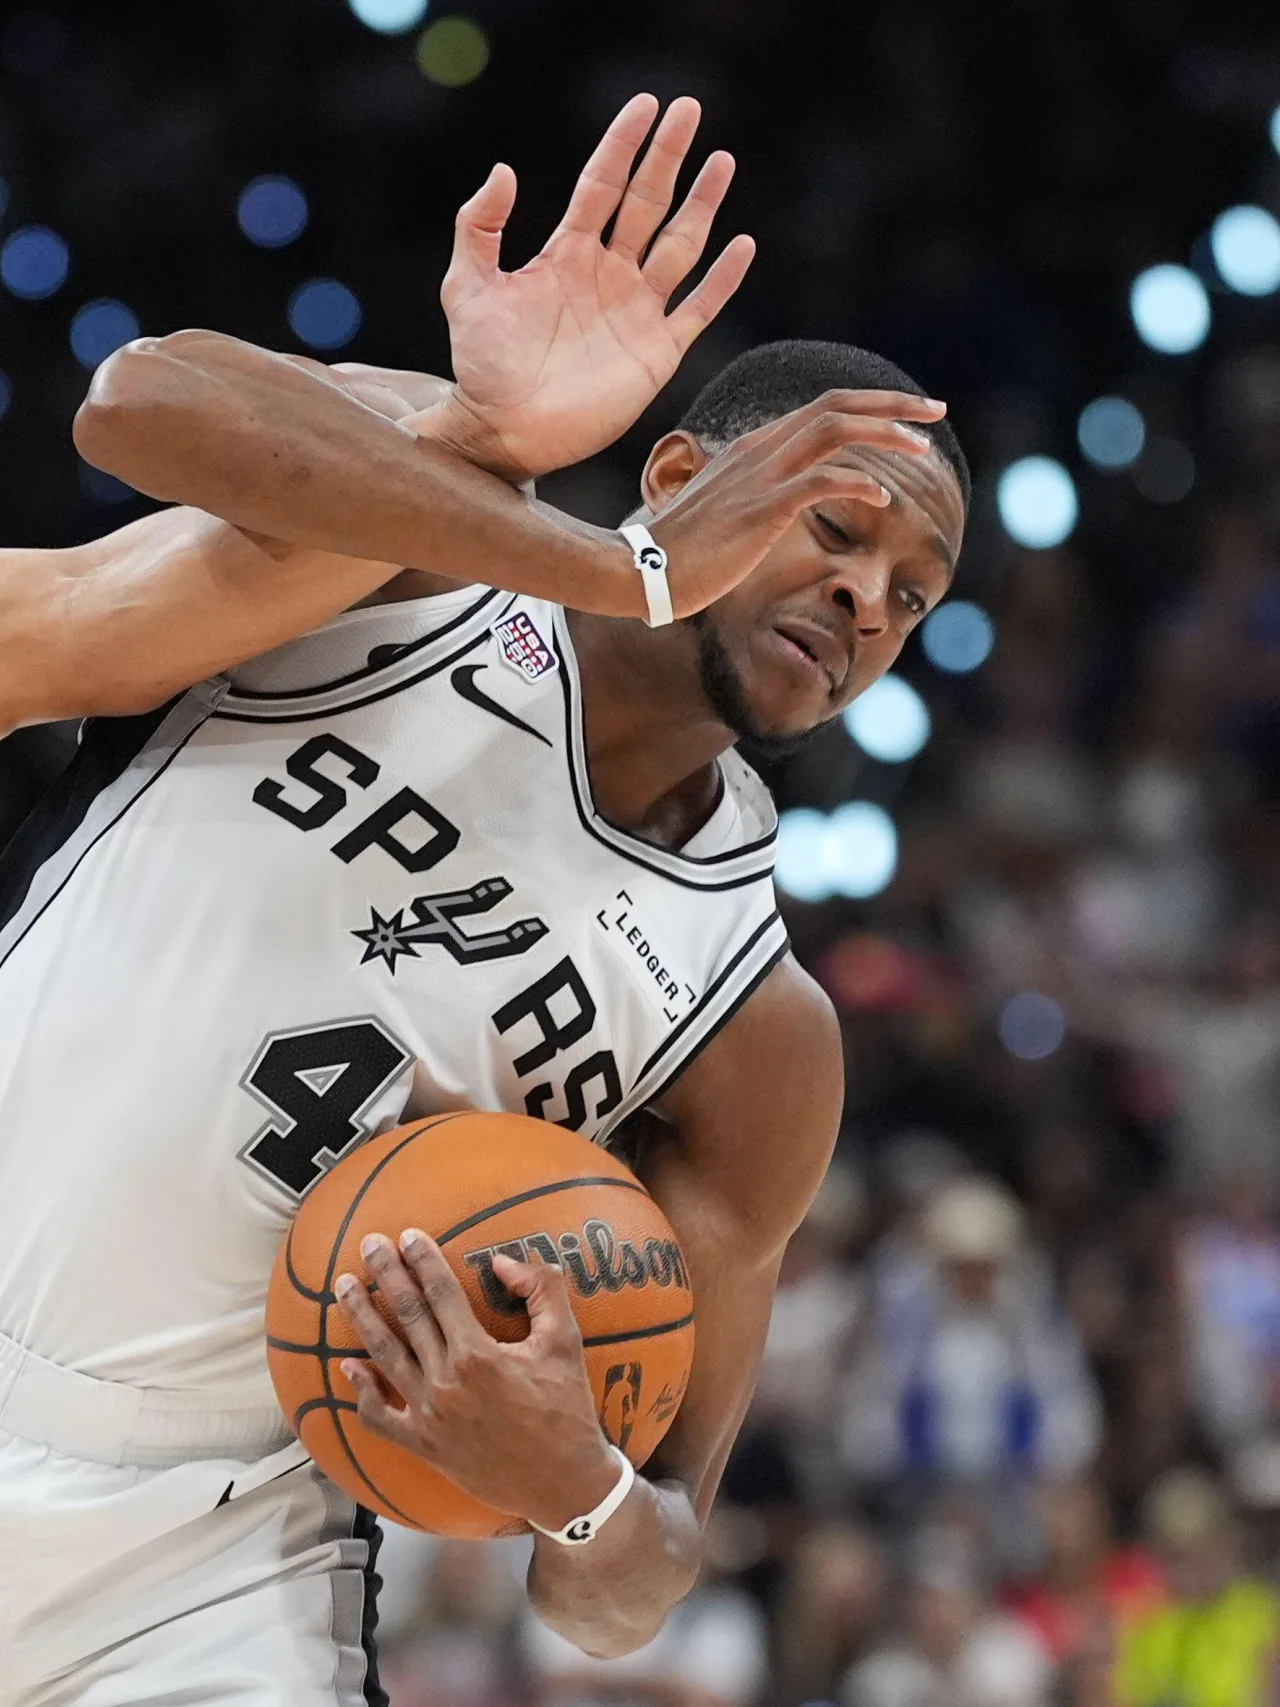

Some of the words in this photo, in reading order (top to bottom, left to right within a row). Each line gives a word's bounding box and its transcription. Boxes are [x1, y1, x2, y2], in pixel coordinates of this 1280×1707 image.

[495, 624, 539, 677] 250
[515, 615, 549, 667] USA
[252, 733, 623, 1132] SPURS
[615, 911, 679, 1001] LEDGER
[236, 1013, 418, 1199] 4
